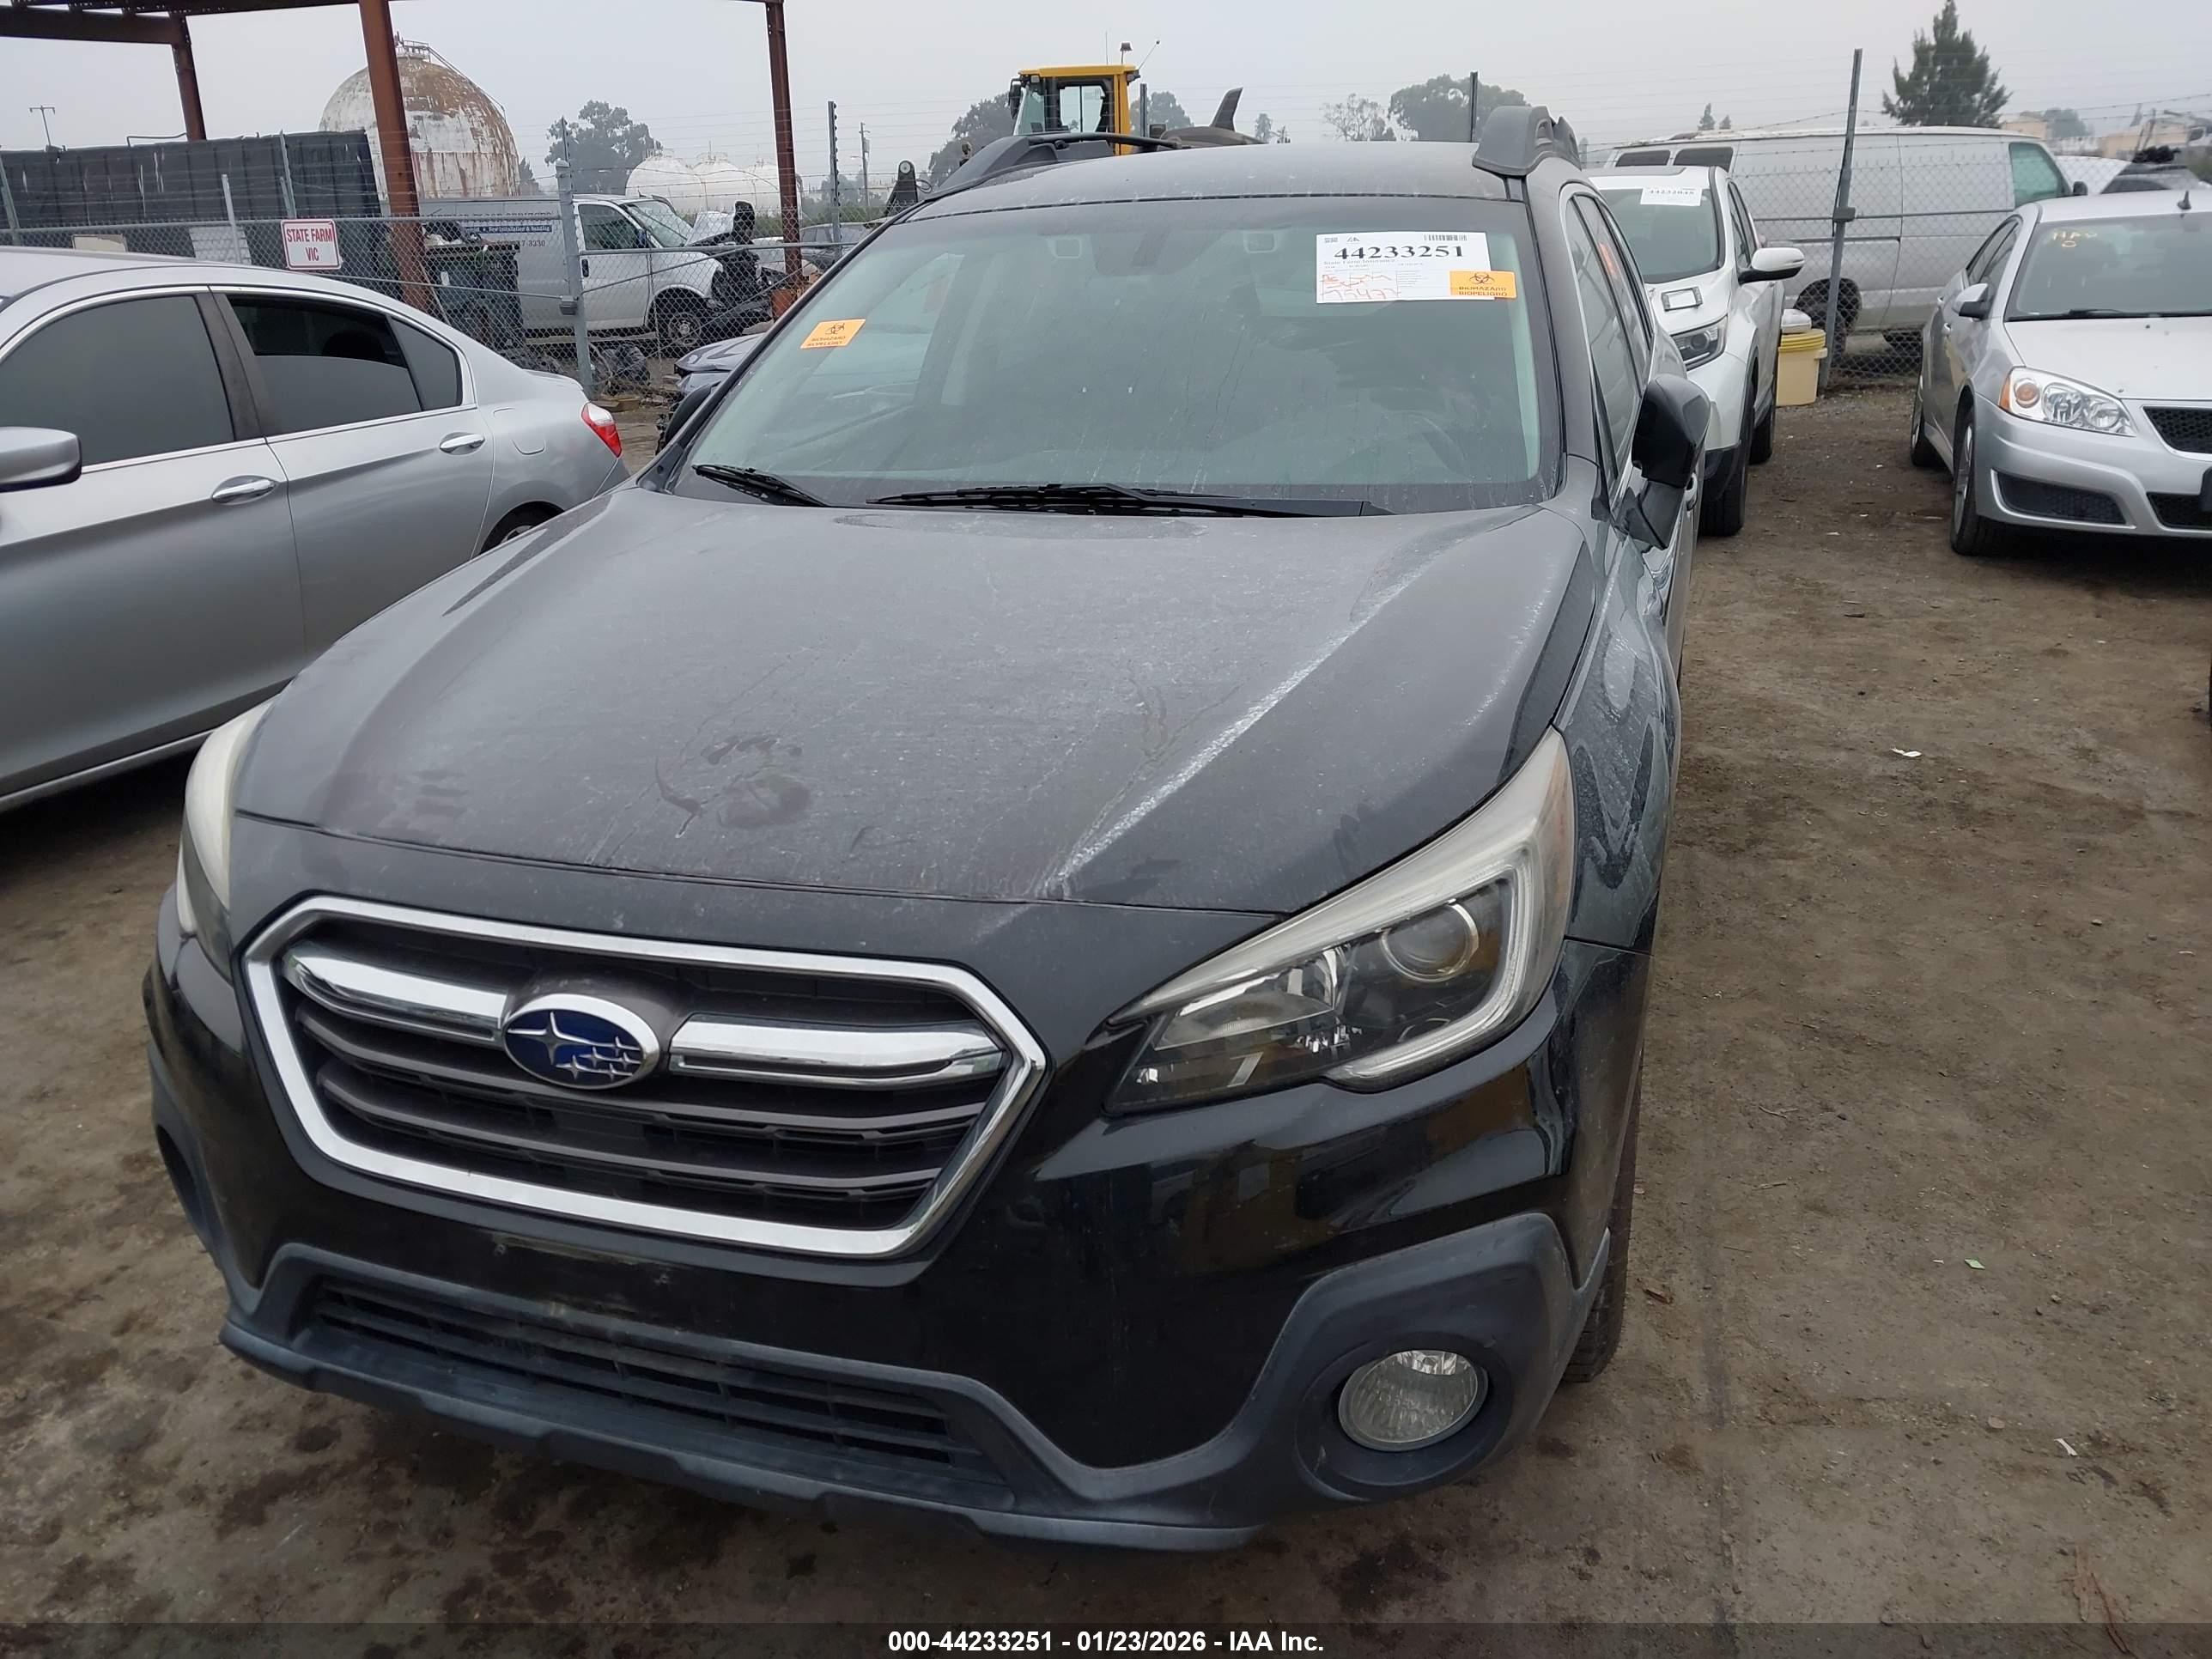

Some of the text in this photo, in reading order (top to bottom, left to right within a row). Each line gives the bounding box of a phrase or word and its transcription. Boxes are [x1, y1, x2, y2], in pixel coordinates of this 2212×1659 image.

[286, 228, 333, 242] STATE FARM
[305, 246, 319, 262] VIC
[1334, 246, 1463, 259] 44233251
